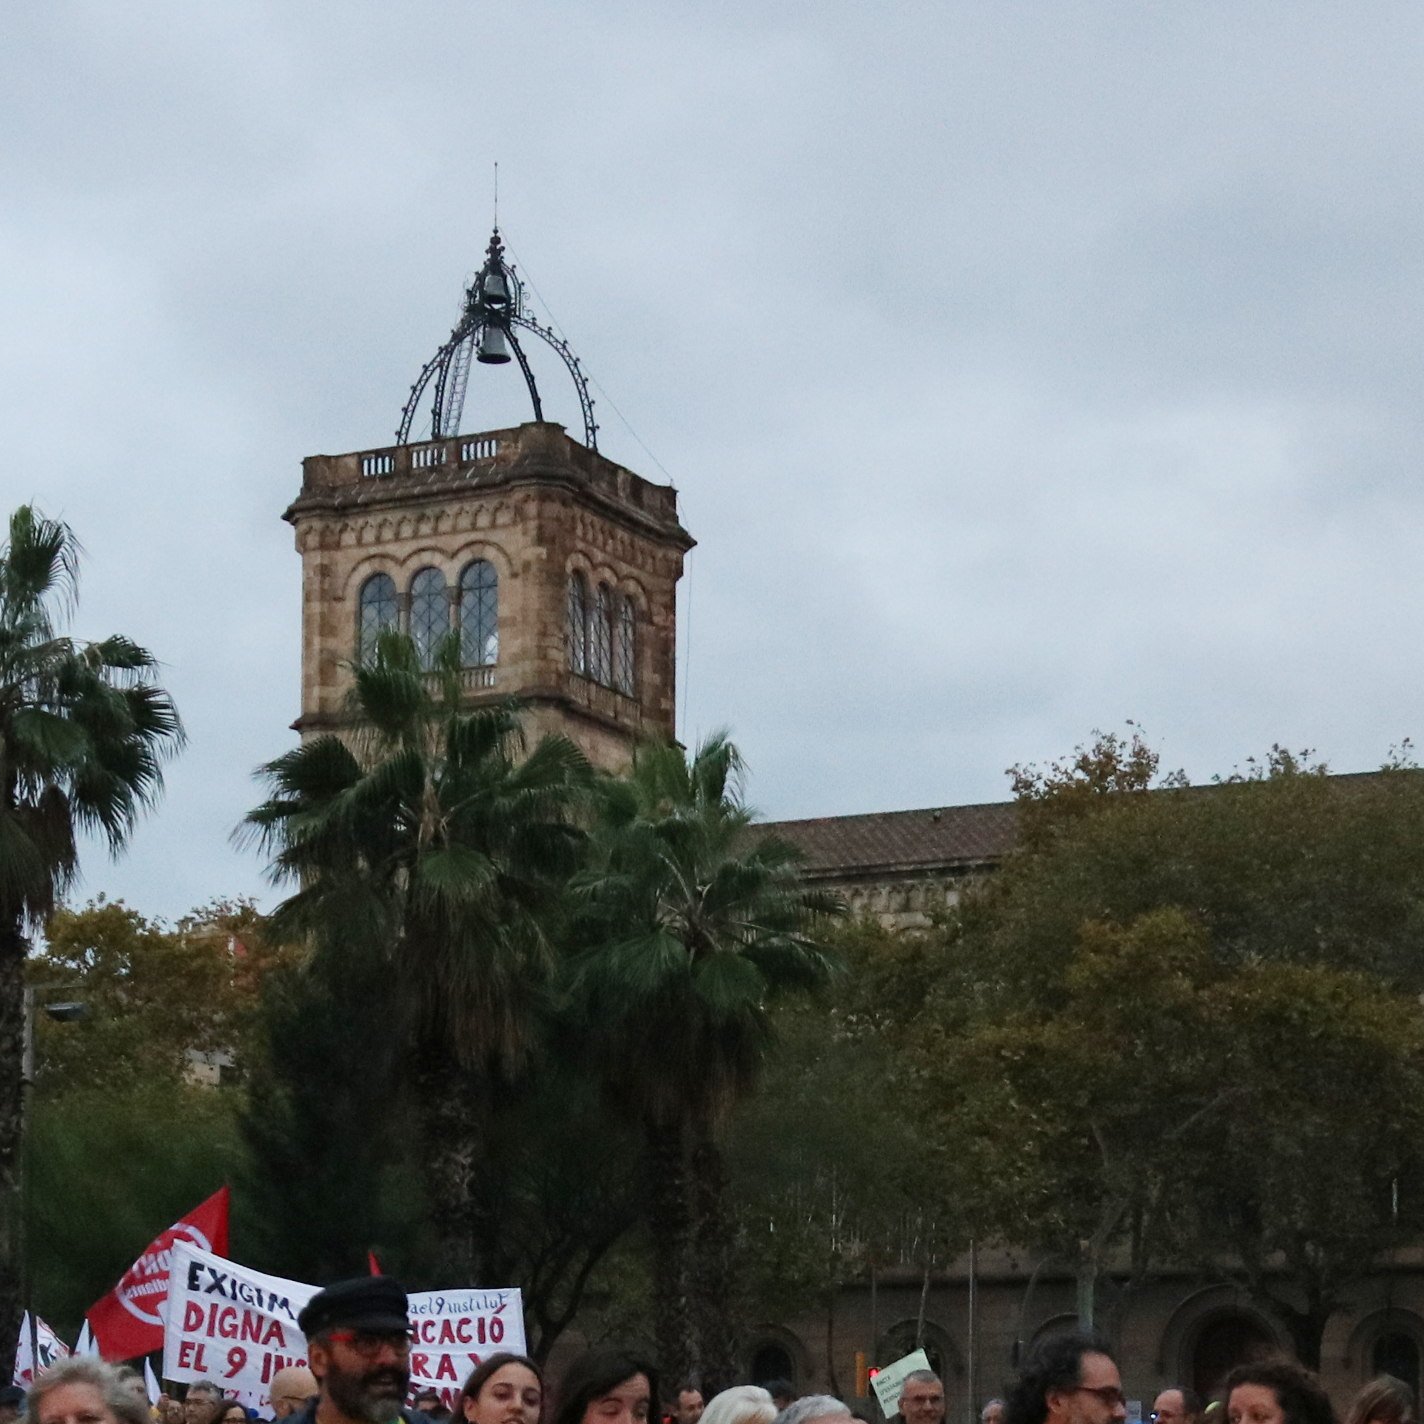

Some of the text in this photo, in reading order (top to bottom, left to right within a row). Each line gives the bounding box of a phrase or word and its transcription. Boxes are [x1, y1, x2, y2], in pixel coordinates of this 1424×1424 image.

[187, 1261, 295, 1320] EXIGIM
[183, 1300, 286, 1348] DIGNA
[178, 1341, 208, 1373] EL
[224, 1346, 247, 1378] 9
